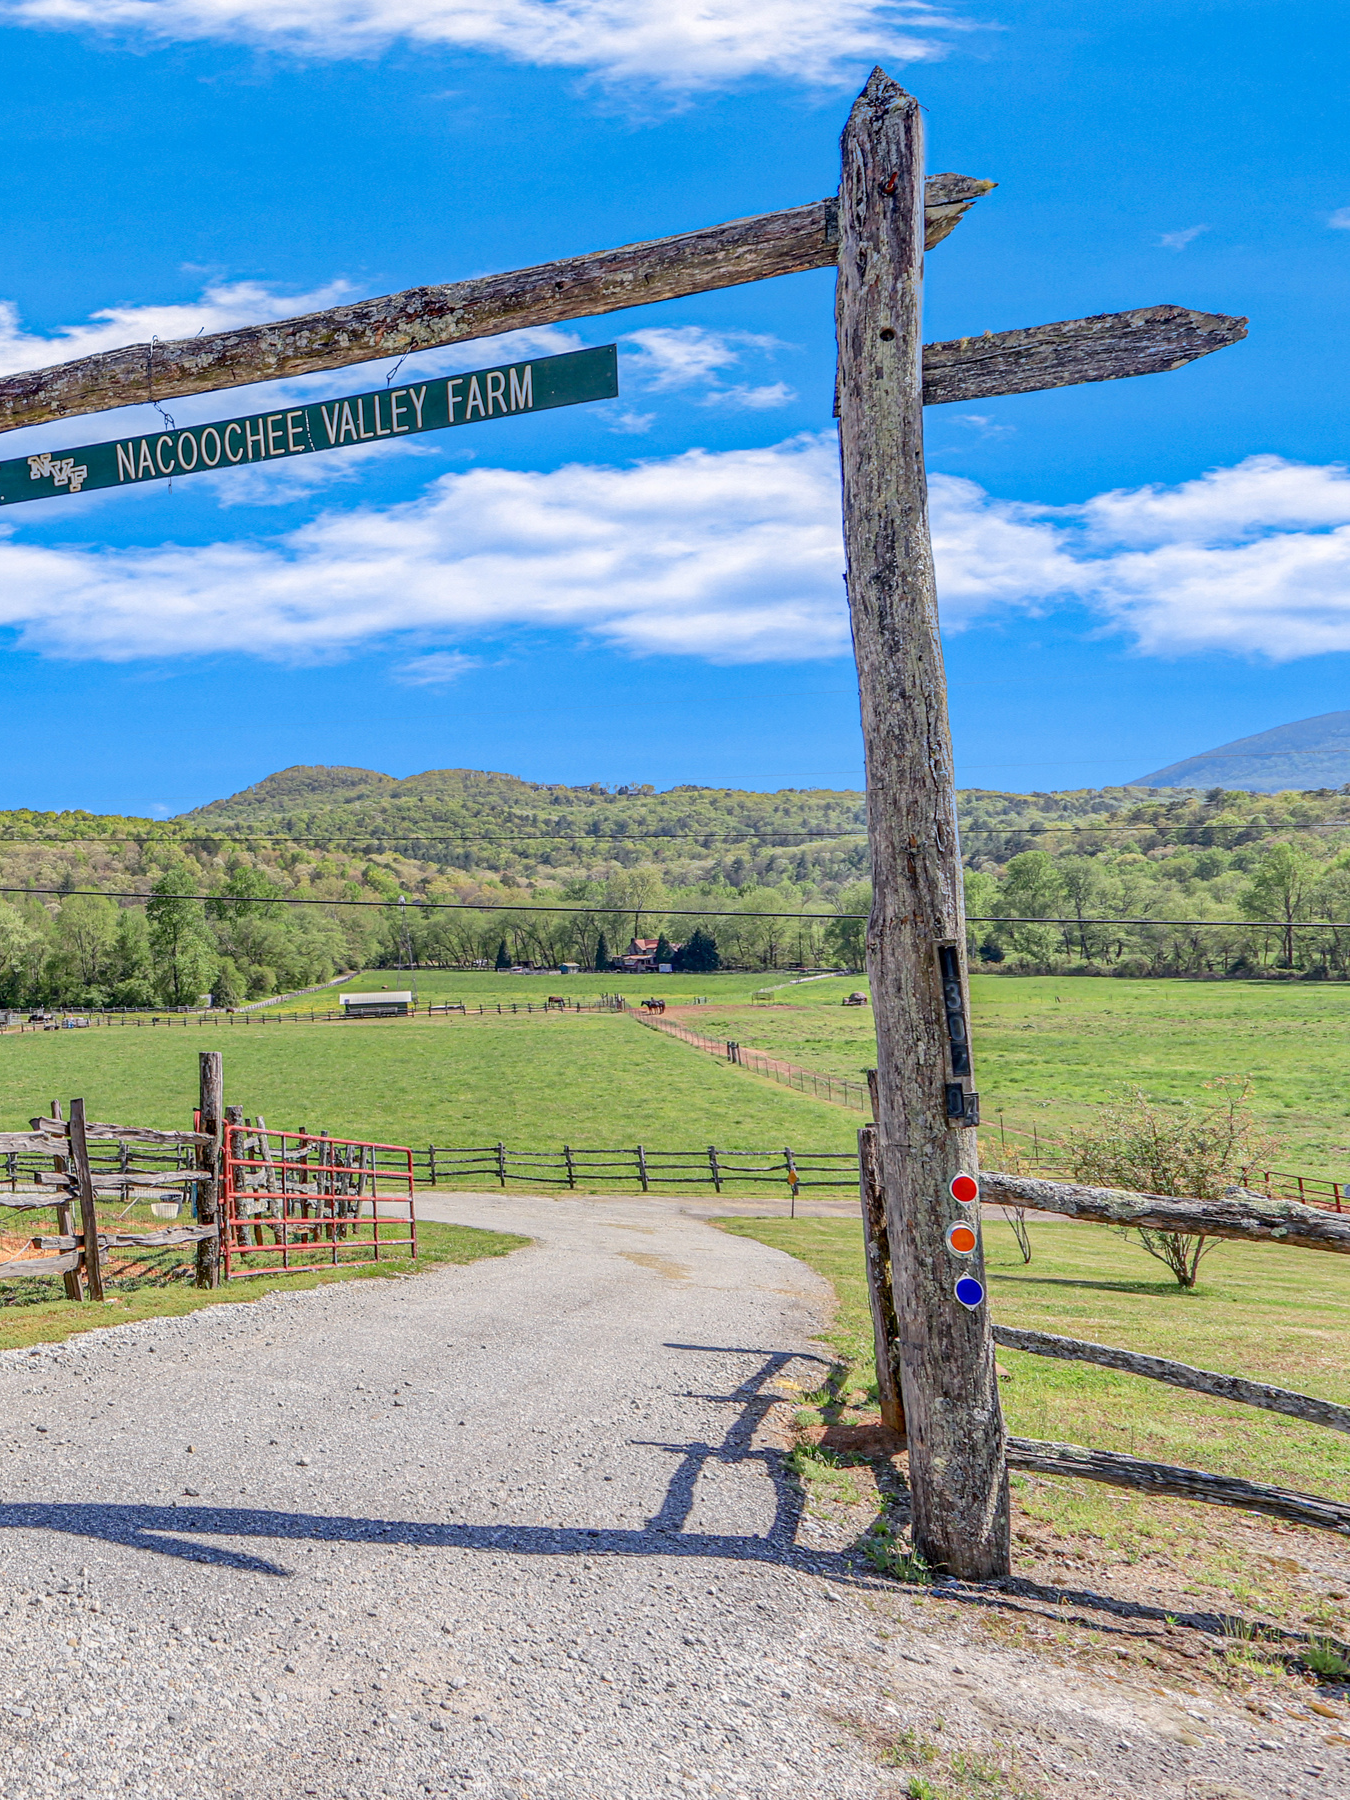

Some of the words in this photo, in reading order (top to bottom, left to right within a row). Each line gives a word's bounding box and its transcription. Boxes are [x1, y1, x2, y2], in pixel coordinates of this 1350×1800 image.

[27, 453, 88, 493] NVF
[116, 411, 305, 482] NACOOCHEE
[321, 385, 427, 444] VALLEY
[447, 365, 534, 423] FARM
